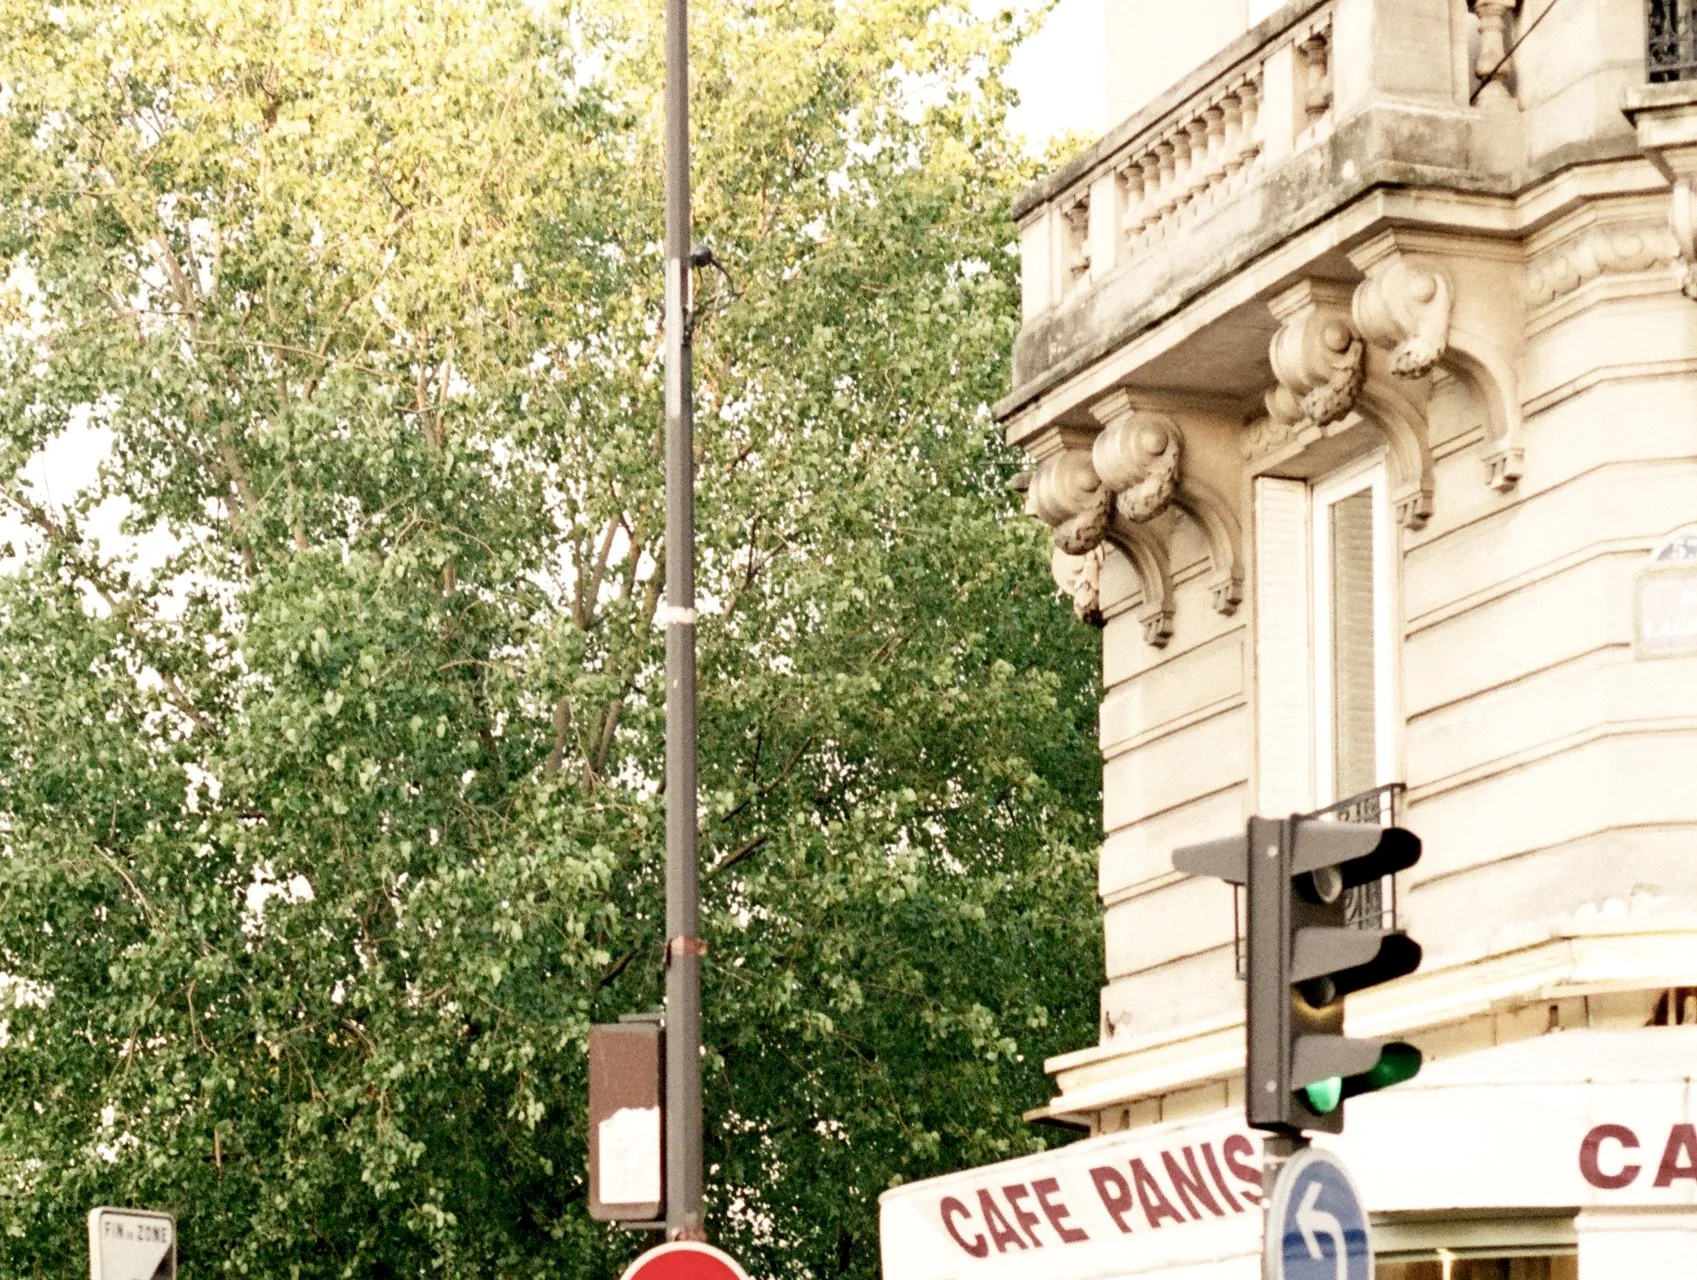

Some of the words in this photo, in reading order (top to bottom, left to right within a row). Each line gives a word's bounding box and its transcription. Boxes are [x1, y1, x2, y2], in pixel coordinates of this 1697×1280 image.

[104, 1221, 124, 1240] FIN
[137, 1224, 167, 1244] ZONE
[940, 1177, 1090, 1258] CAFE
[1089, 1134, 1263, 1234] PANIS
